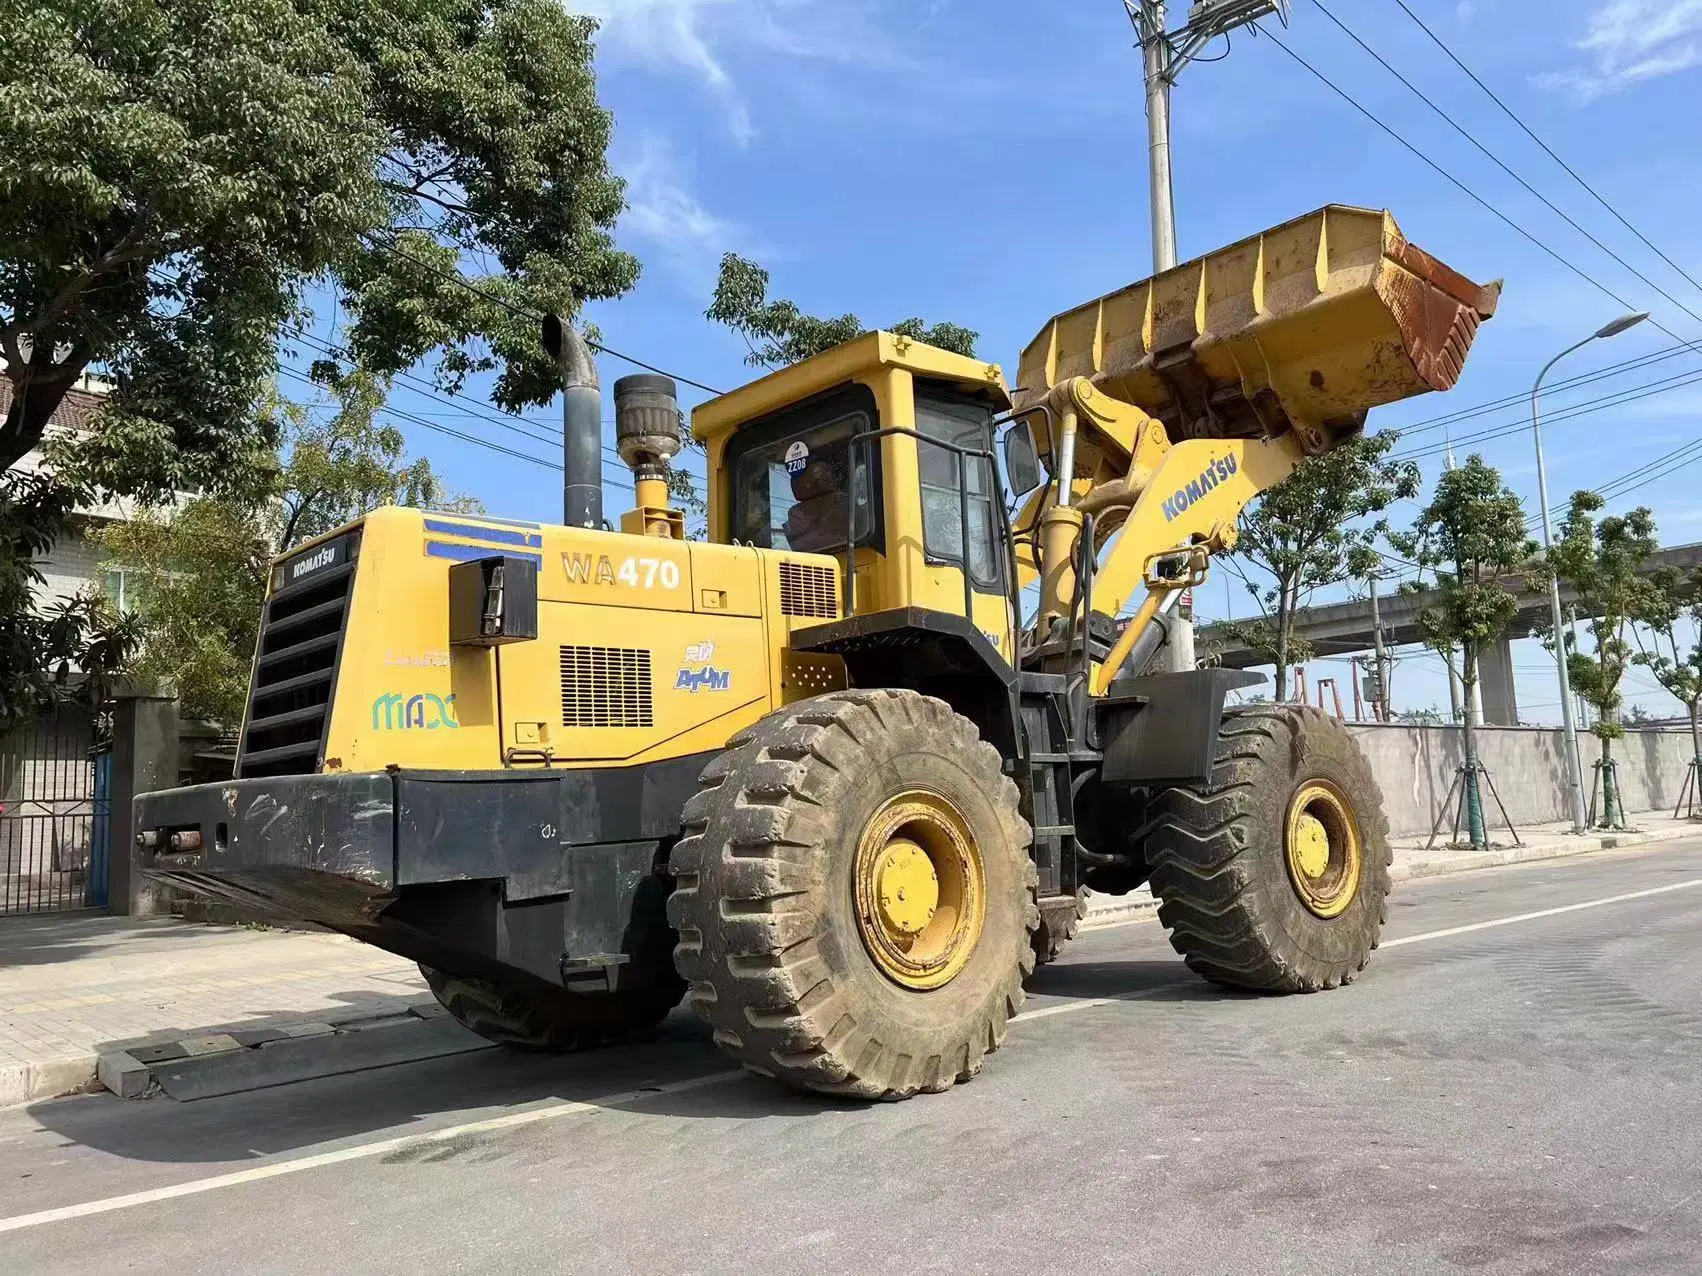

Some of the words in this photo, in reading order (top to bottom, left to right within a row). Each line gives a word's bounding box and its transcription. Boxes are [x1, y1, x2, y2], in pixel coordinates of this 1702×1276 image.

[1161, 452, 1238, 522] KOMATSU
[293, 547, 335, 578] KOMATSU
[560, 551, 680, 590] WA470
